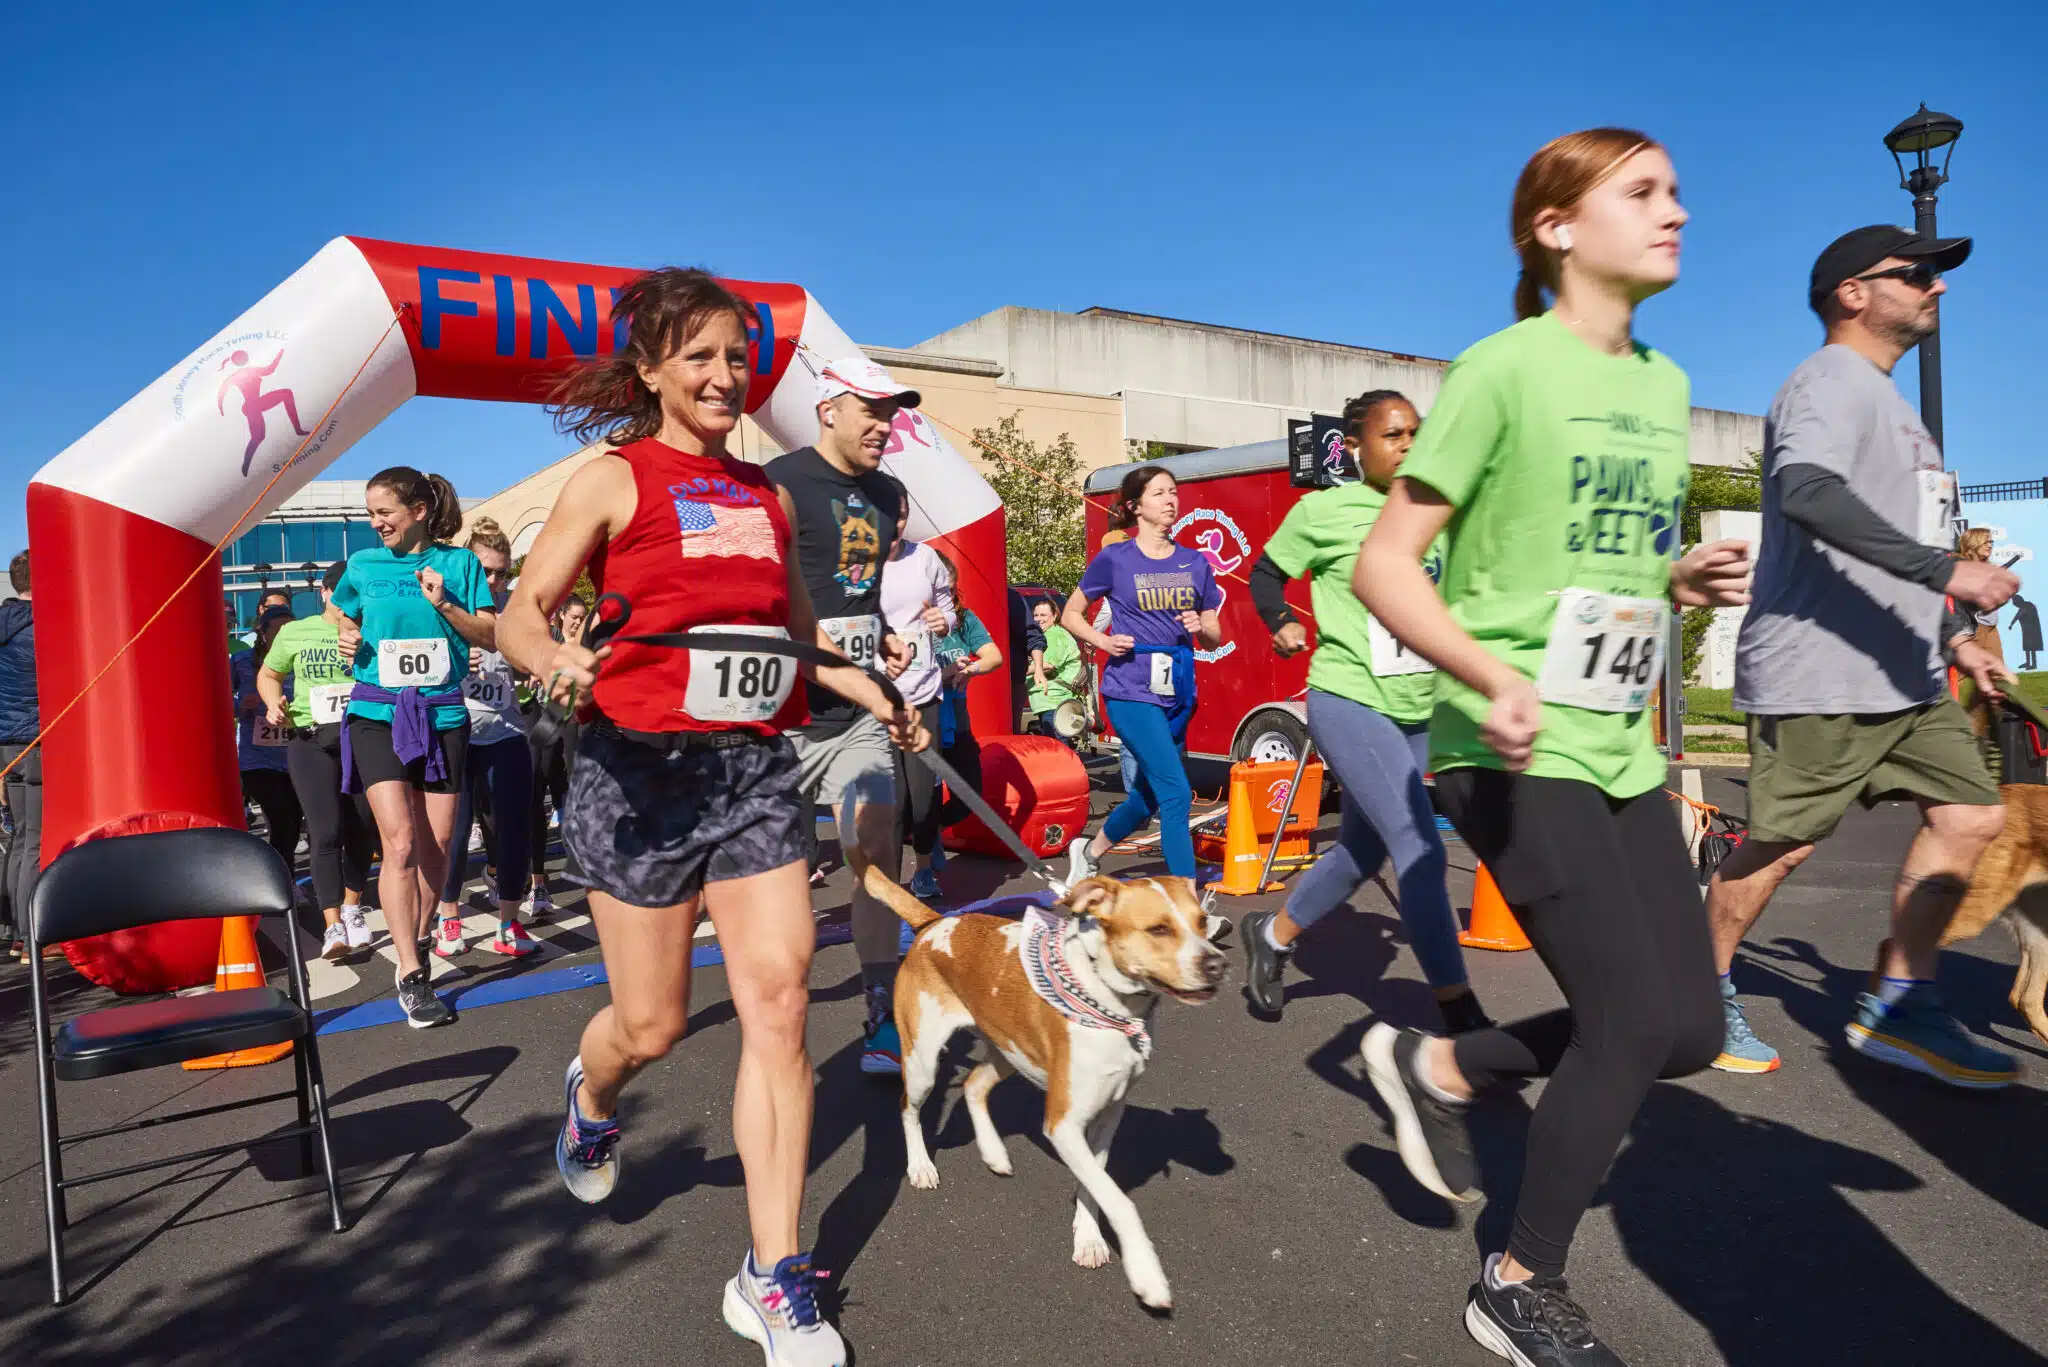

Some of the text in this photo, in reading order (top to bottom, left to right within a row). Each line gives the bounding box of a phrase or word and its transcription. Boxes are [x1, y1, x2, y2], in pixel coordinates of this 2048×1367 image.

[417, 265, 776, 376] FINIH
[668, 477, 709, 499] OLD
[1171, 508, 1251, 555] Jersey Race Timing LLC
[1137, 586, 1195, 612] DUKES
[300, 648, 337, 663] PAWS
[399, 653, 430, 675] 60
[1582, 632, 1655, 686] 148
[714, 656, 782, 699] 180
[326, 695, 350, 712] 75
[469, 683, 504, 702] 201
